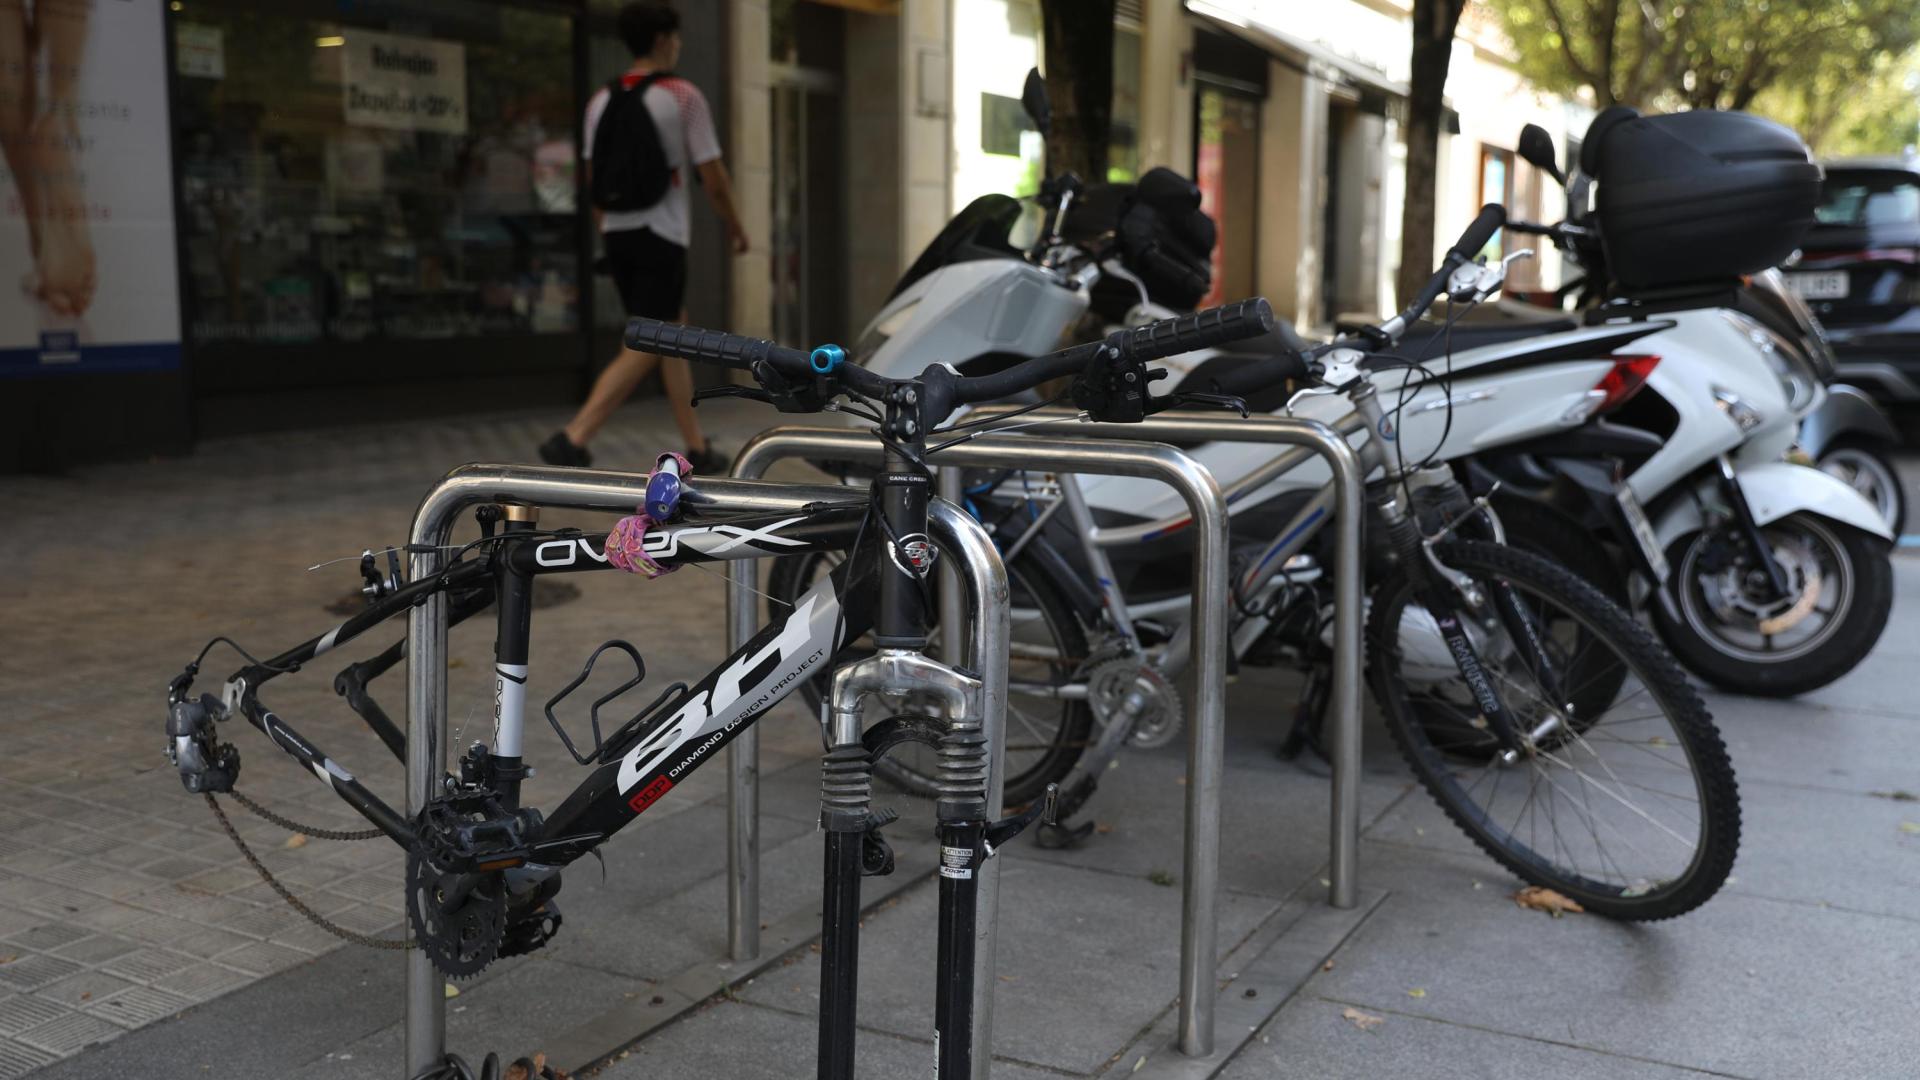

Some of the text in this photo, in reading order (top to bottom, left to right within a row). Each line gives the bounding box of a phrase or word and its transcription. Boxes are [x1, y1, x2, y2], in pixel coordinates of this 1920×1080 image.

[616, 593, 818, 797] BH
[668, 647, 824, 778] DIAMOND DESIGN PROJECT
